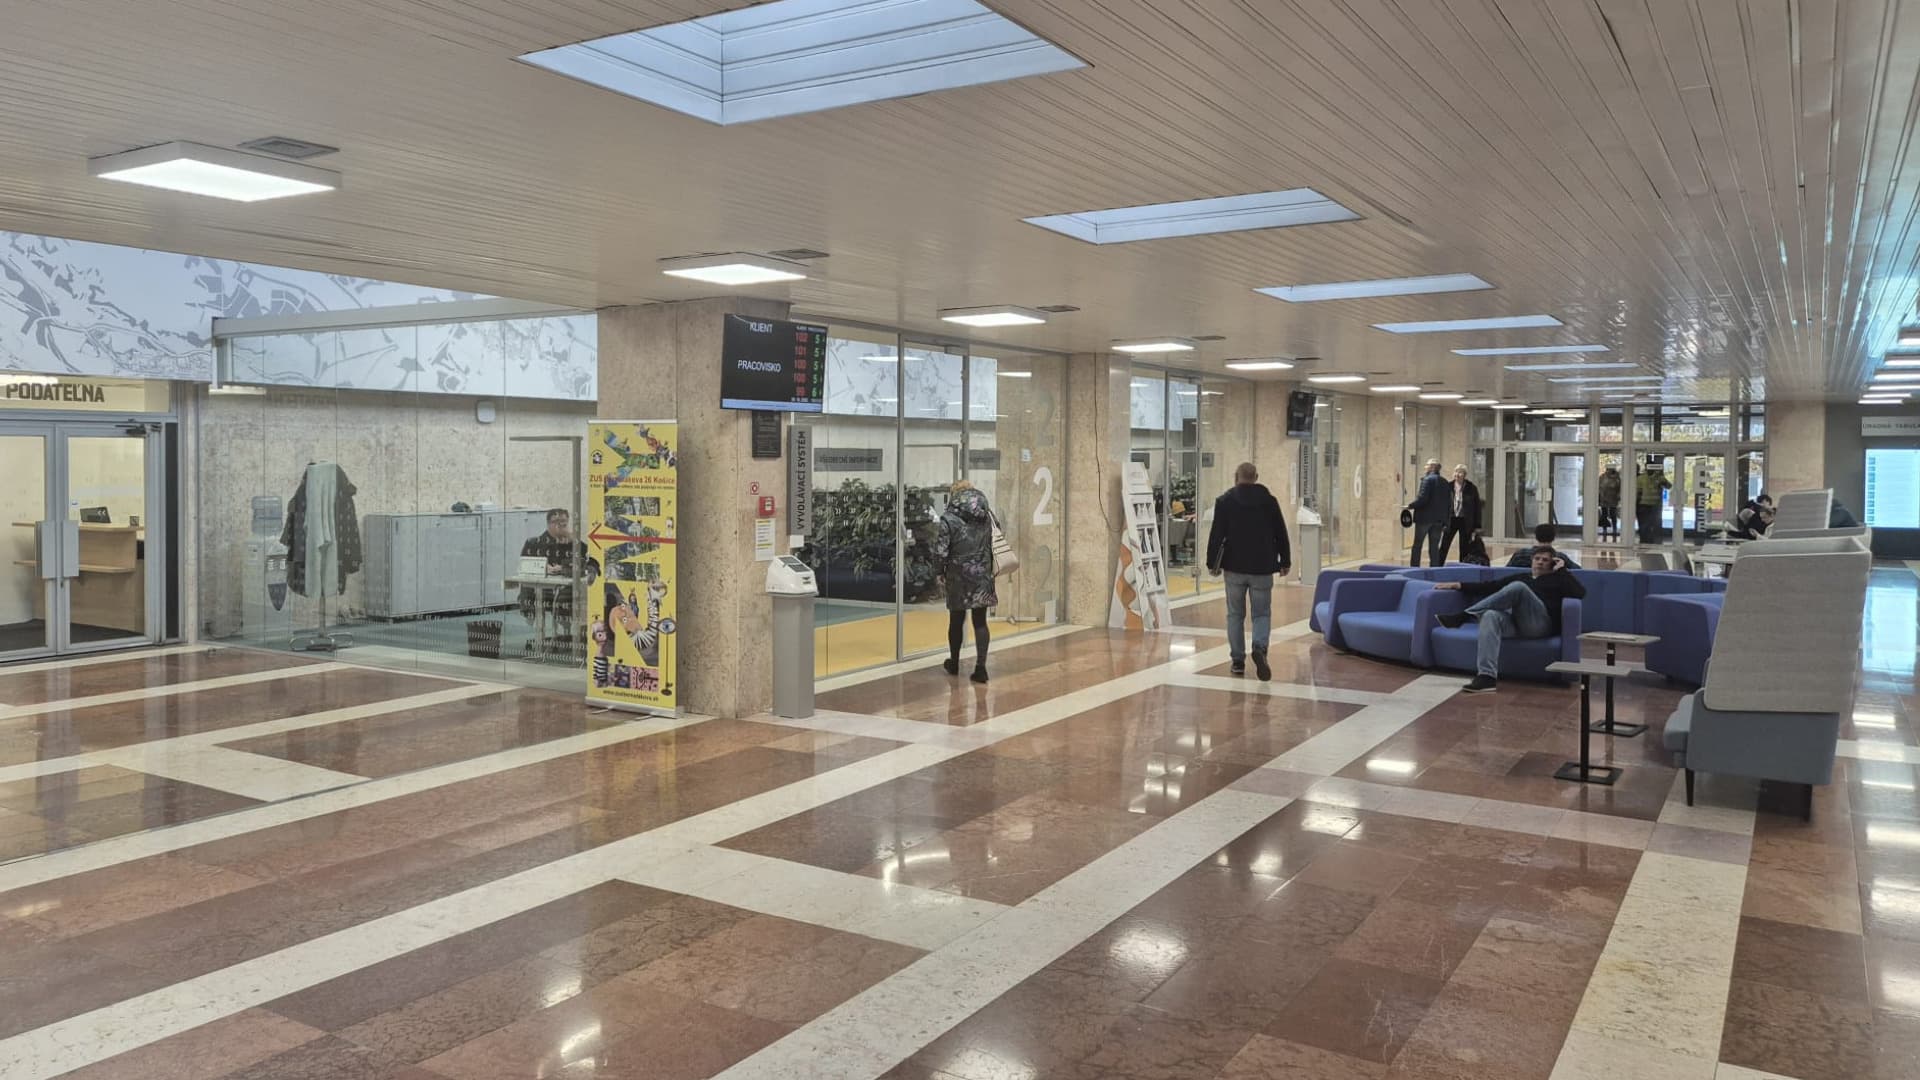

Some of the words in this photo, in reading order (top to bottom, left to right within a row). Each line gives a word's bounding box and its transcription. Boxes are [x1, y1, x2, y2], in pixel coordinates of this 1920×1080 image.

[750, 322, 773, 333] KLIENT
[815, 334, 820, 344] 5
[814, 348, 819, 358] 5
[738, 360, 781, 372] PRACOVISKO
[814, 361, 819, 370] 5
[813, 375, 818, 384] 5
[1354, 464, 1362, 499] 6
[1033, 466, 1053, 525] 2
